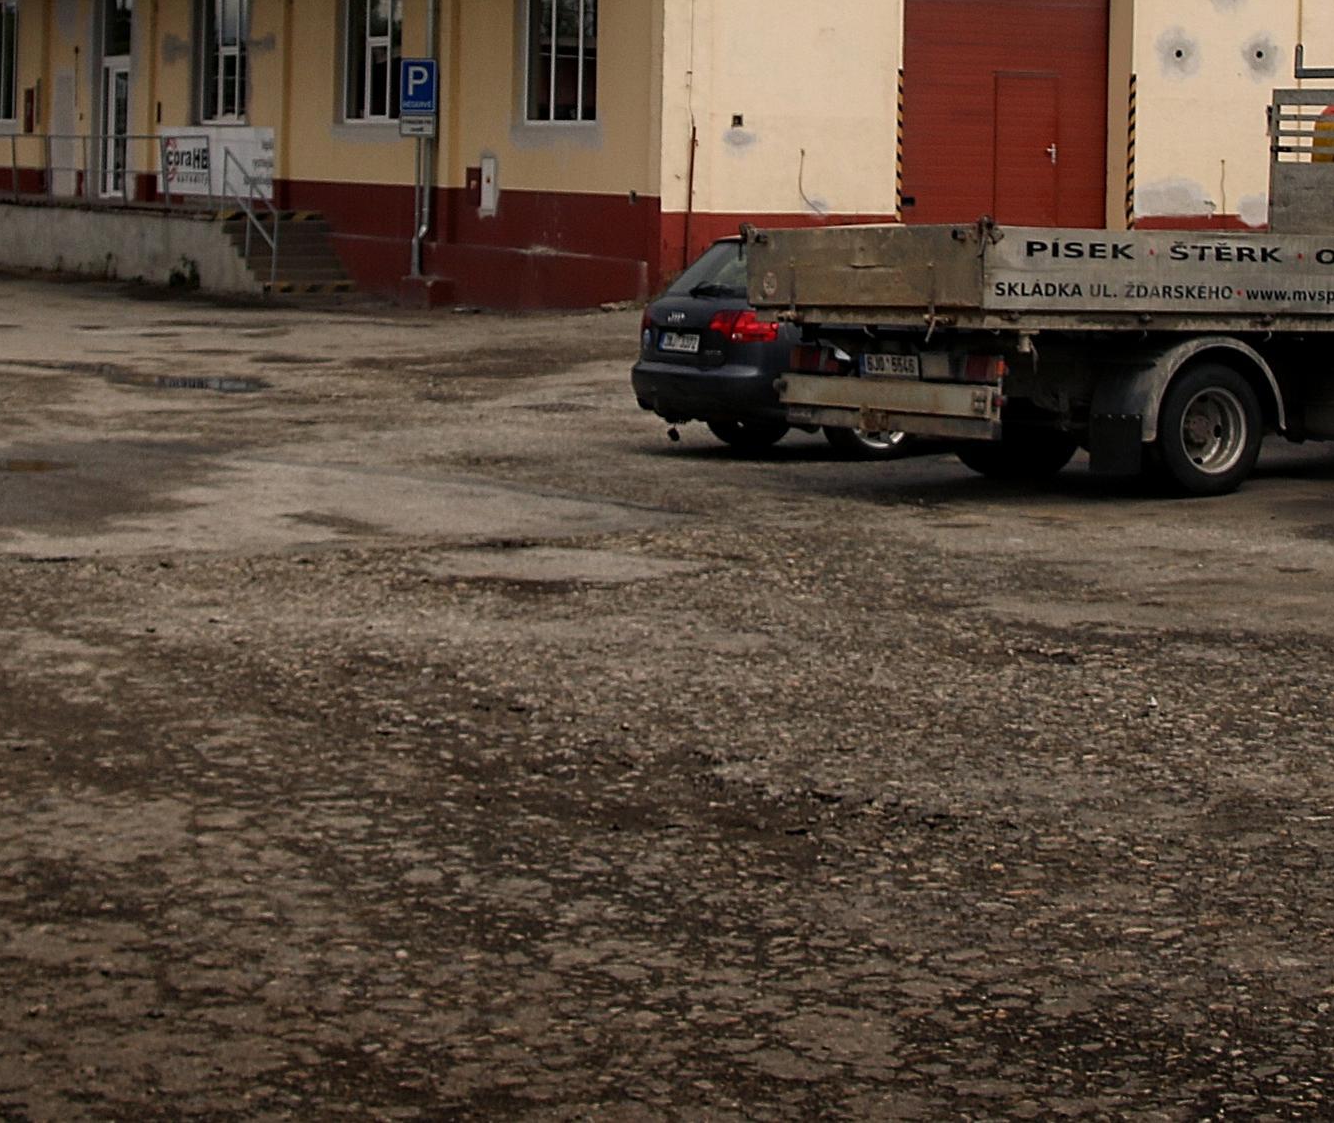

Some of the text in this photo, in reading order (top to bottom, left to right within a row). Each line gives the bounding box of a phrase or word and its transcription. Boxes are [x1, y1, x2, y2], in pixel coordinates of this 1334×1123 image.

[407, 66, 429, 96] P
[1026, 238, 1135, 260] PÍSEK
[1169, 241, 1283, 263] ŠTĚRK
[994, 279, 1083, 298] SKLÁDKA
[1089, 282, 1118, 298] UL.
